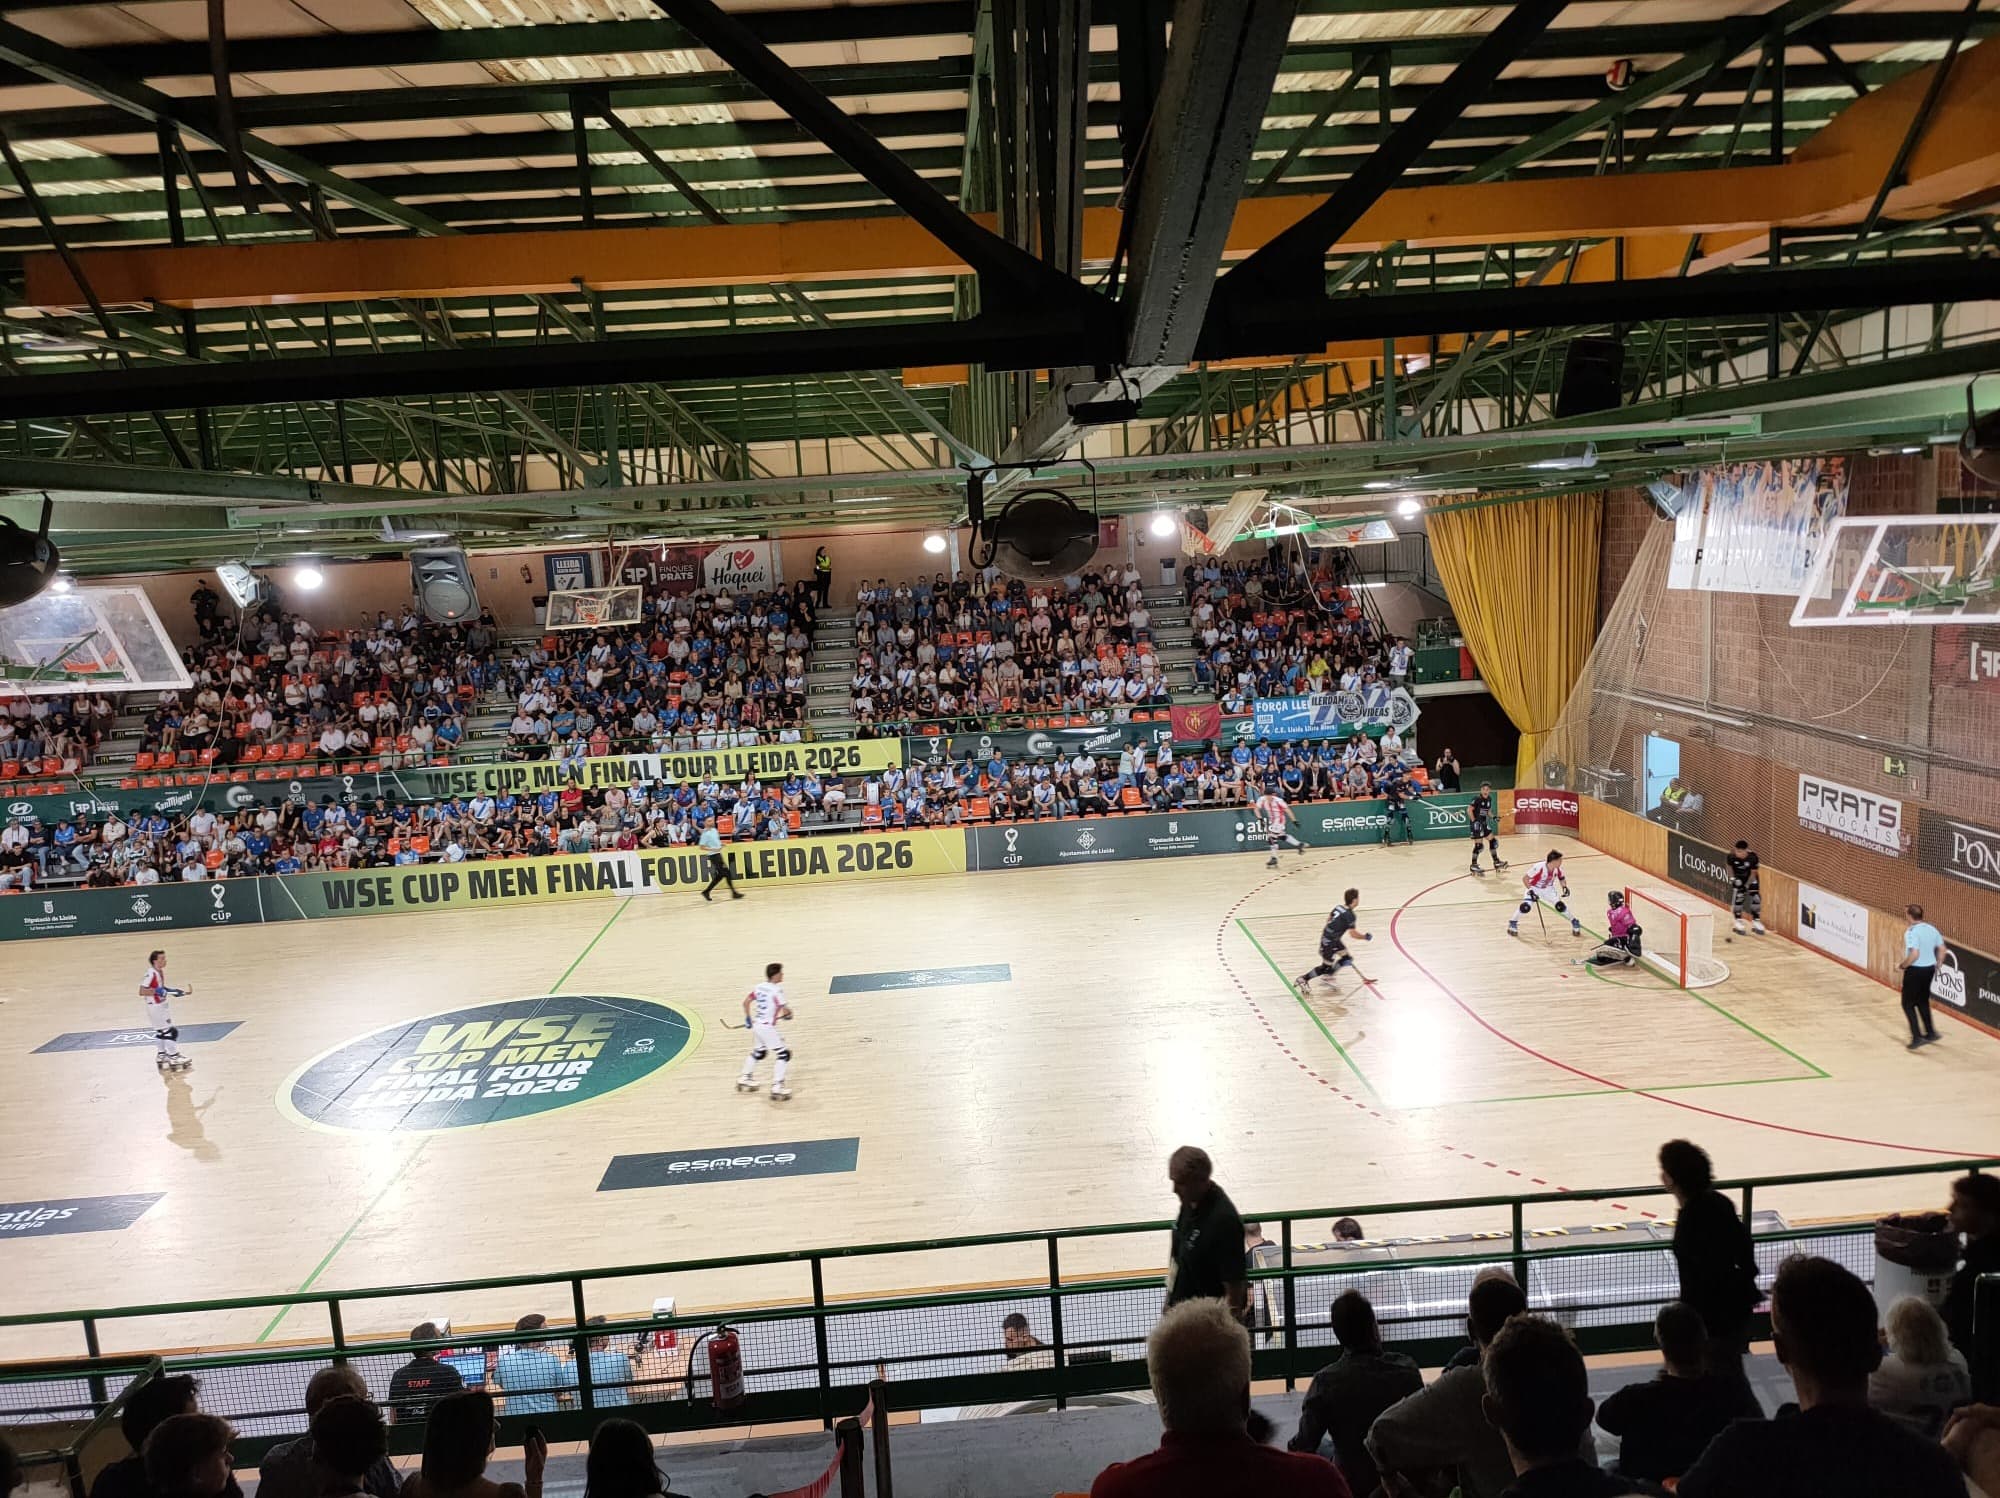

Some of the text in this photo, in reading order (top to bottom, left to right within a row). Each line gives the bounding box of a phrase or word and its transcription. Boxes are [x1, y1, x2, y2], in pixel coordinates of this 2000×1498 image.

[660, 564, 694, 572] FINQUES
[660, 572, 694, 581] PRATS
[711, 566, 764, 590] Hoquei
[1256, 700, 1289, 714] FORÇA
[426, 745, 861, 795] WSE CUP MEN FINAL FOUR LLEIDA 2026
[1516, 797, 1578, 813] esmeca
[1803, 780, 1897, 829] PRATS
[1321, 814, 1388, 830] esmeca
[1428, 809, 1467, 825] PONS
[1805, 804, 1893, 843] ADVOCATS
[1952, 831, 2000, 874] PON
[322, 876, 395, 910] WSE
[402, 872, 460, 905] CUP
[468, 866, 538, 900] MEN
[547, 851, 634, 894] FINAL
[727, 846, 830, 881] LLEIDA
[837, 840, 913, 873] 2026
[1937, 987, 1960, 1001] SHOP
[107, 1033, 158, 1043] PON
[412, 1012, 619, 1056] WSE
[386, 1051, 489, 1074] CUP
[488, 1041, 606, 1066] MEN
[367, 1060, 595, 1094] FINAL FOUR
[481, 1077, 582, 1099] 2026
[668, 1153, 797, 1171] esmeca
[407, 1378, 431, 1388] STAFF
